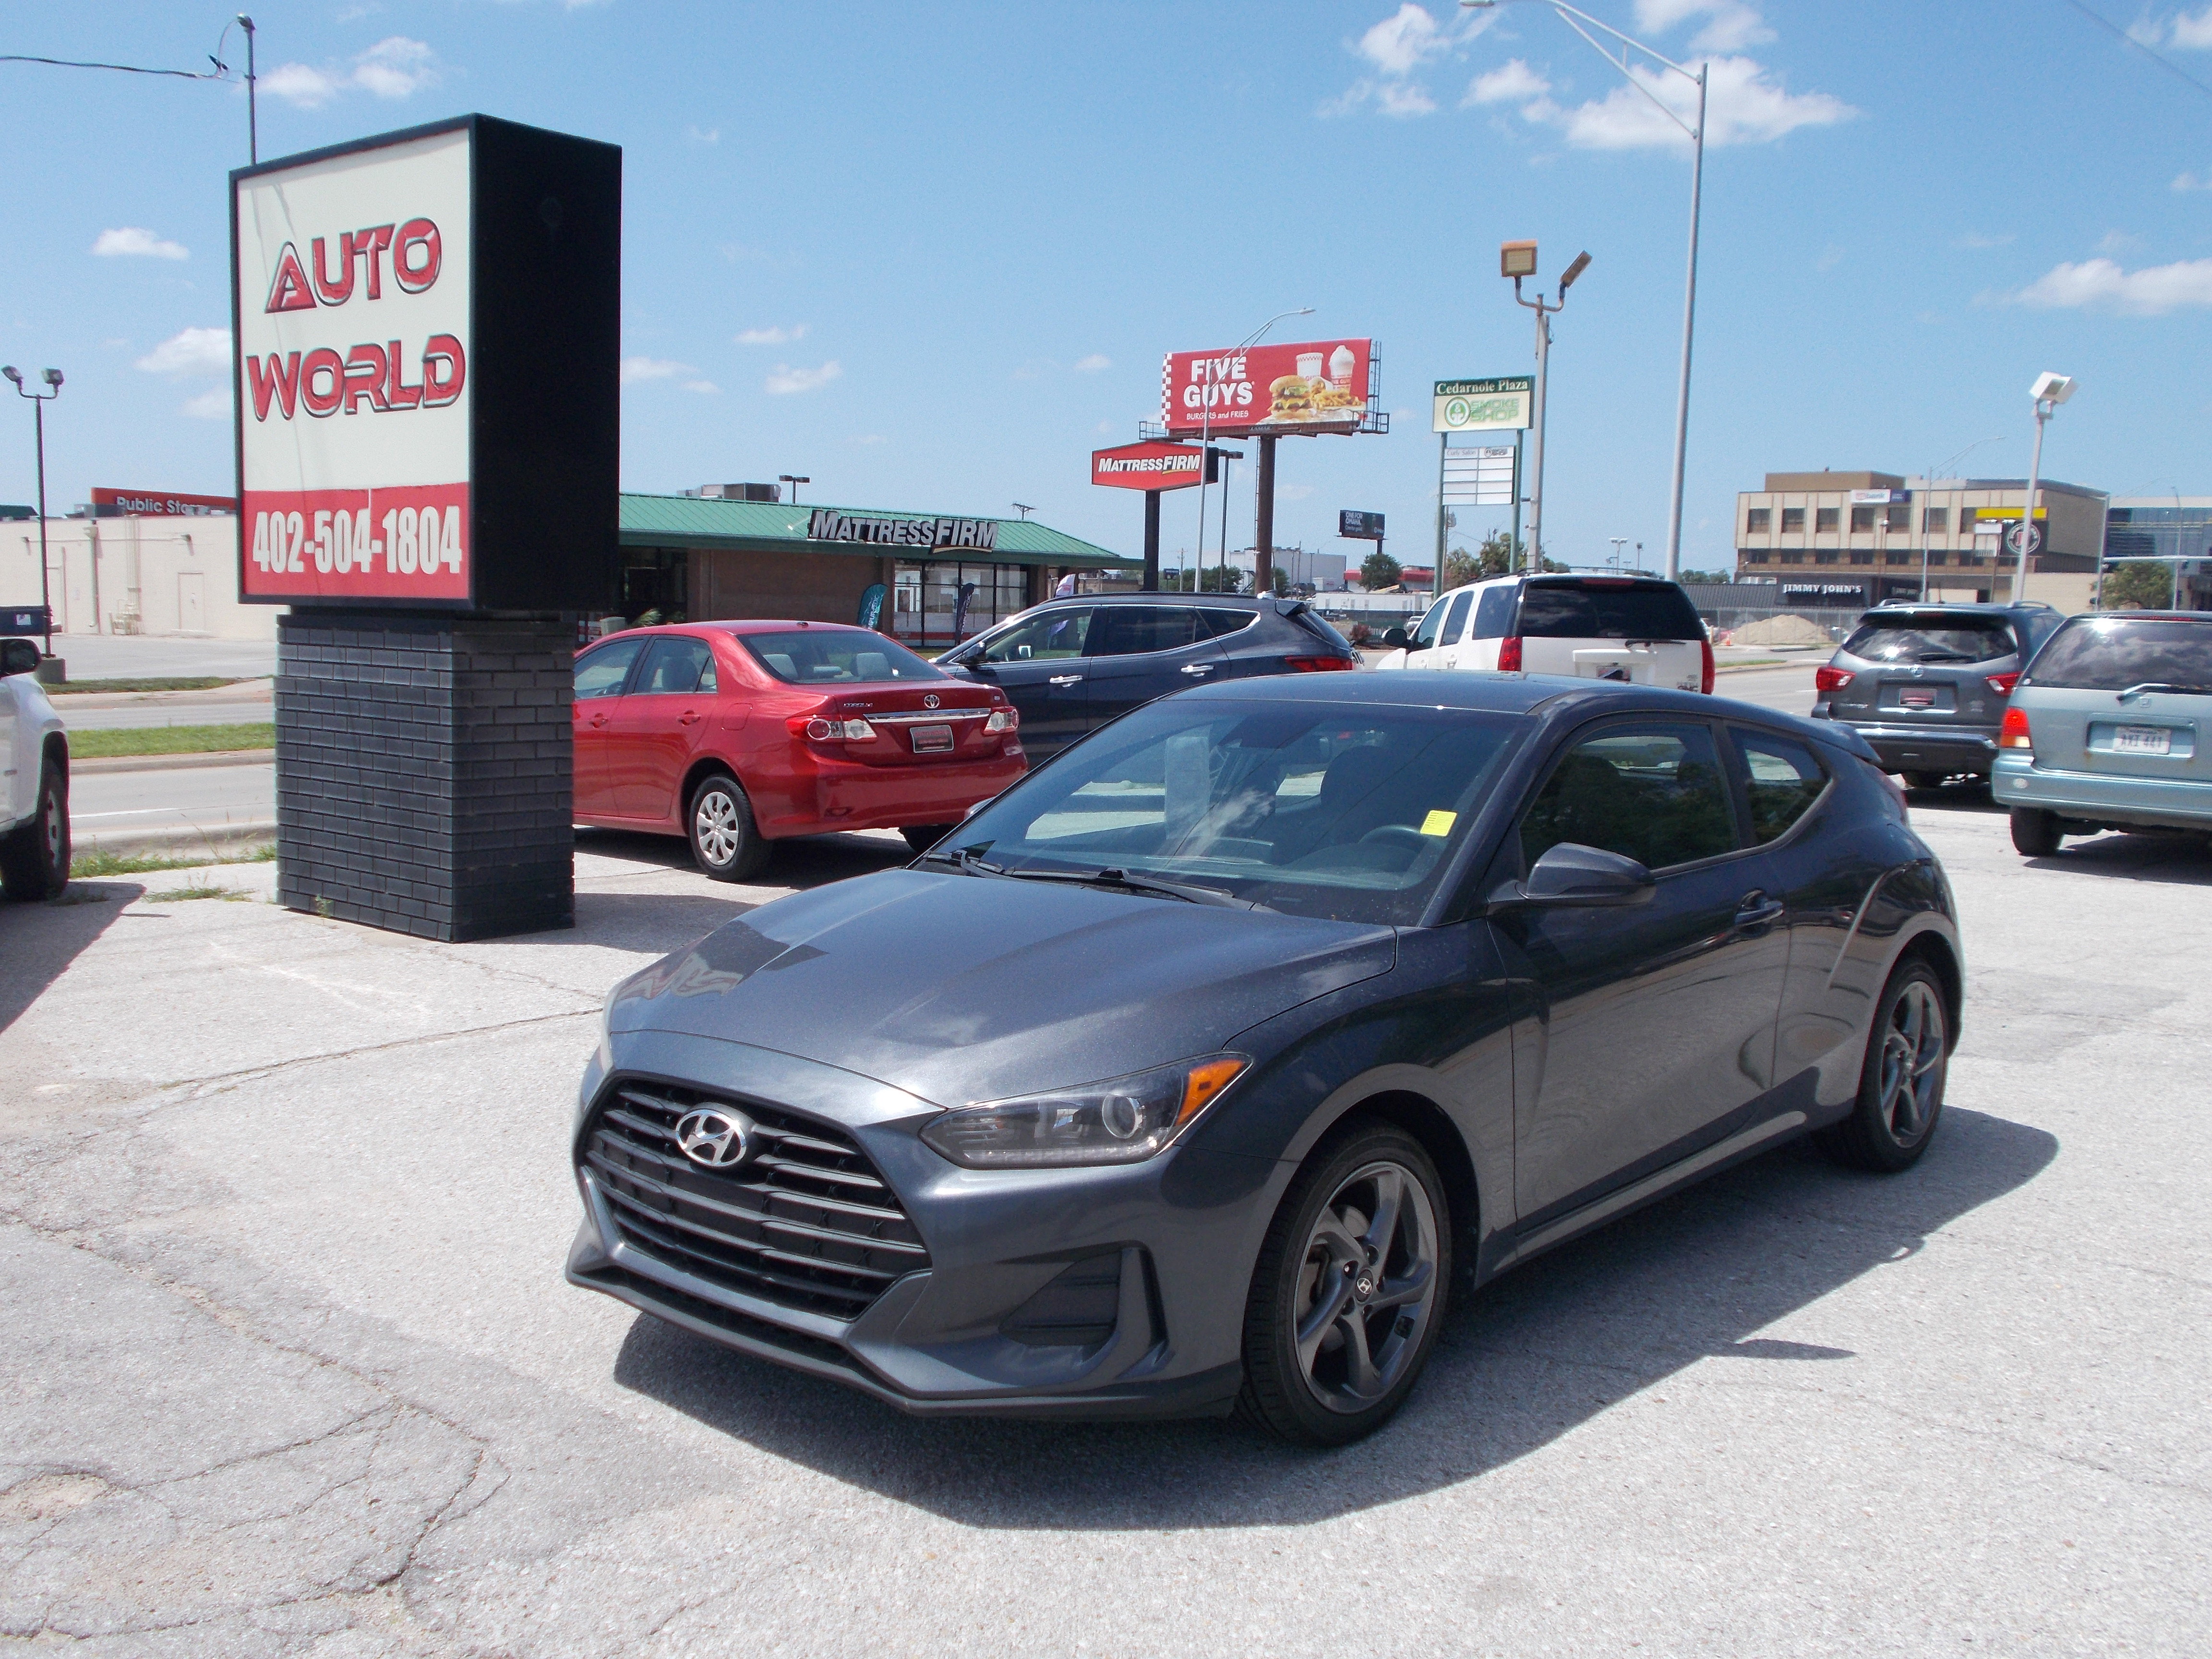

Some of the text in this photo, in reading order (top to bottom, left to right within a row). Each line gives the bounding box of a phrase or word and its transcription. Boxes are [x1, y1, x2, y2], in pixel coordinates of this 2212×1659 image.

[264, 217, 443, 314] AUTO
[246, 333, 466, 422] WORLD
[1191, 356, 1247, 382] FIVE
[1184, 382, 1253, 407] GUYS
[1436, 379, 1528, 394] Cedarnole Plaza
[1470, 408, 1519, 421] SHOP
[116, 496, 163, 513] Public
[252, 505, 462, 574] 402-504-1804
[1783, 583, 1863, 594] JIMMY JOHN'S
